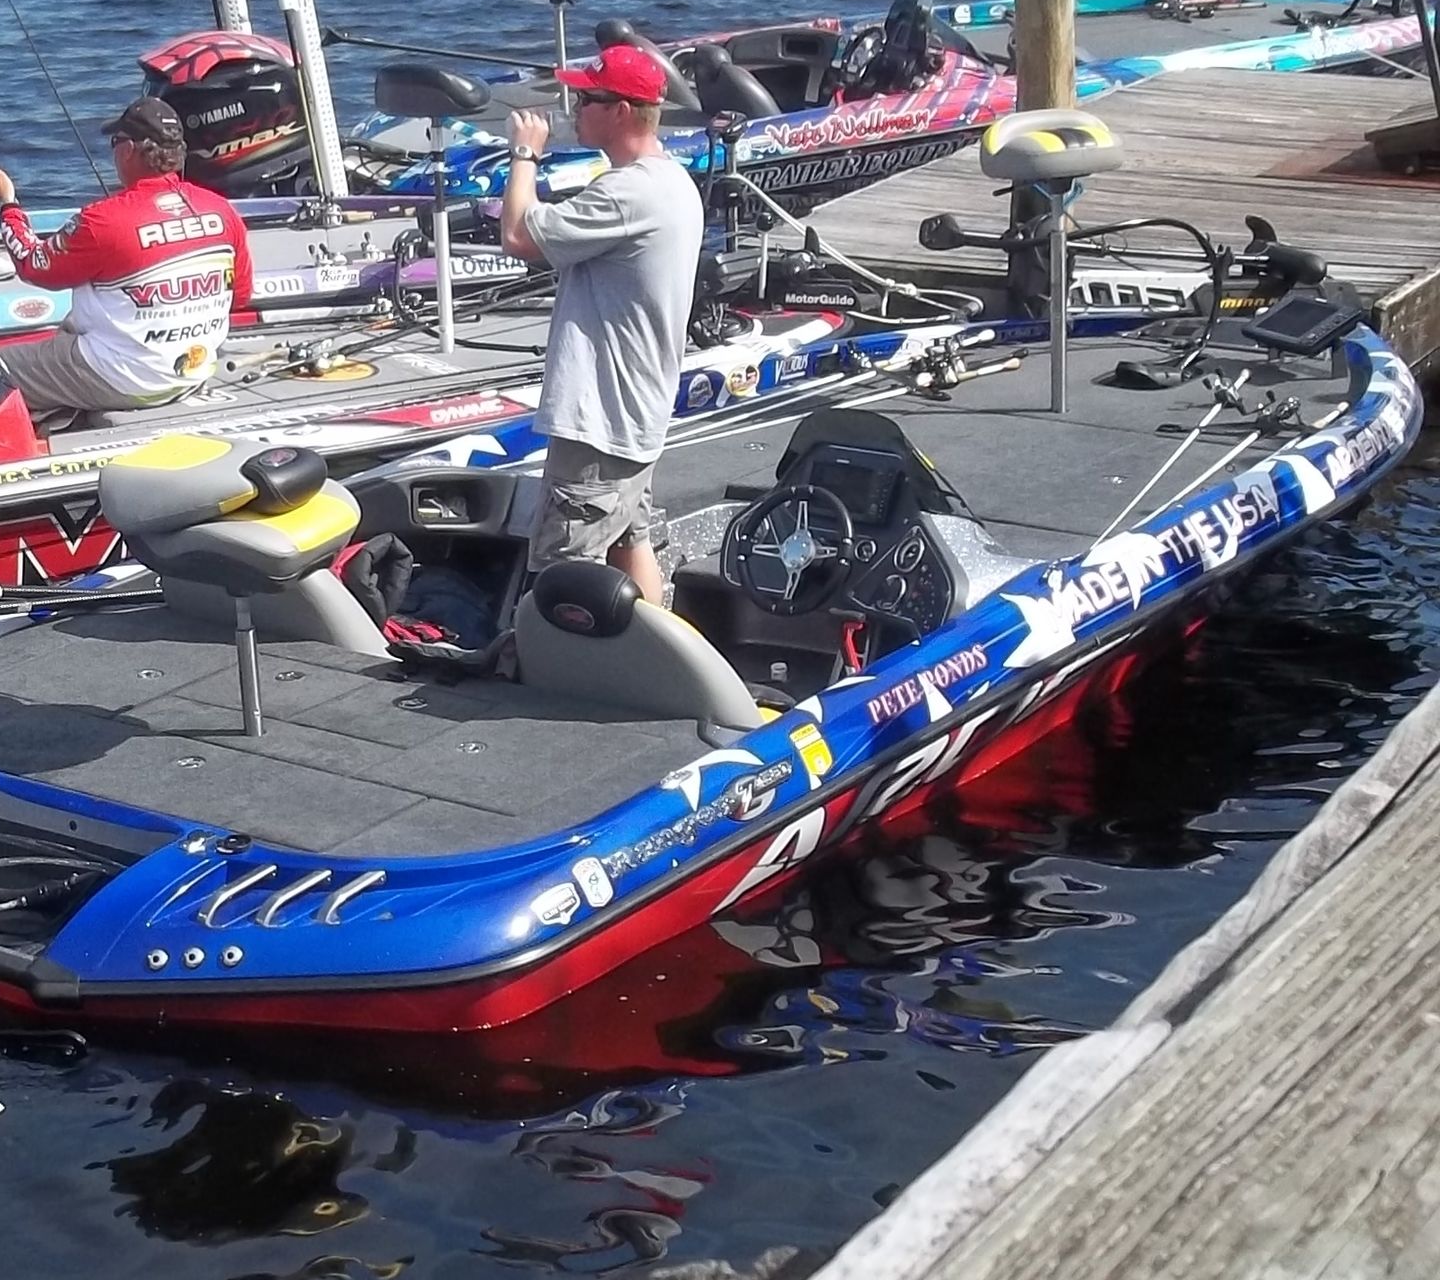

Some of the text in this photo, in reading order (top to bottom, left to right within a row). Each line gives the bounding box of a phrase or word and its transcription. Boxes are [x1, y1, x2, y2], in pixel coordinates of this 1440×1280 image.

[199, 101, 246, 126] YAMAHA
[136, 213, 225, 251] REED
[121, 269, 223, 308] YUM
[784, 293, 856, 306] MotorGuide
[144, 316, 228, 344] MERCURY
[1034, 559, 1132, 633] MADE
[1158, 510, 1221, 565] THE
[1211, 484, 1281, 538] USA
[867, 643, 988, 724] PETE PONDS
